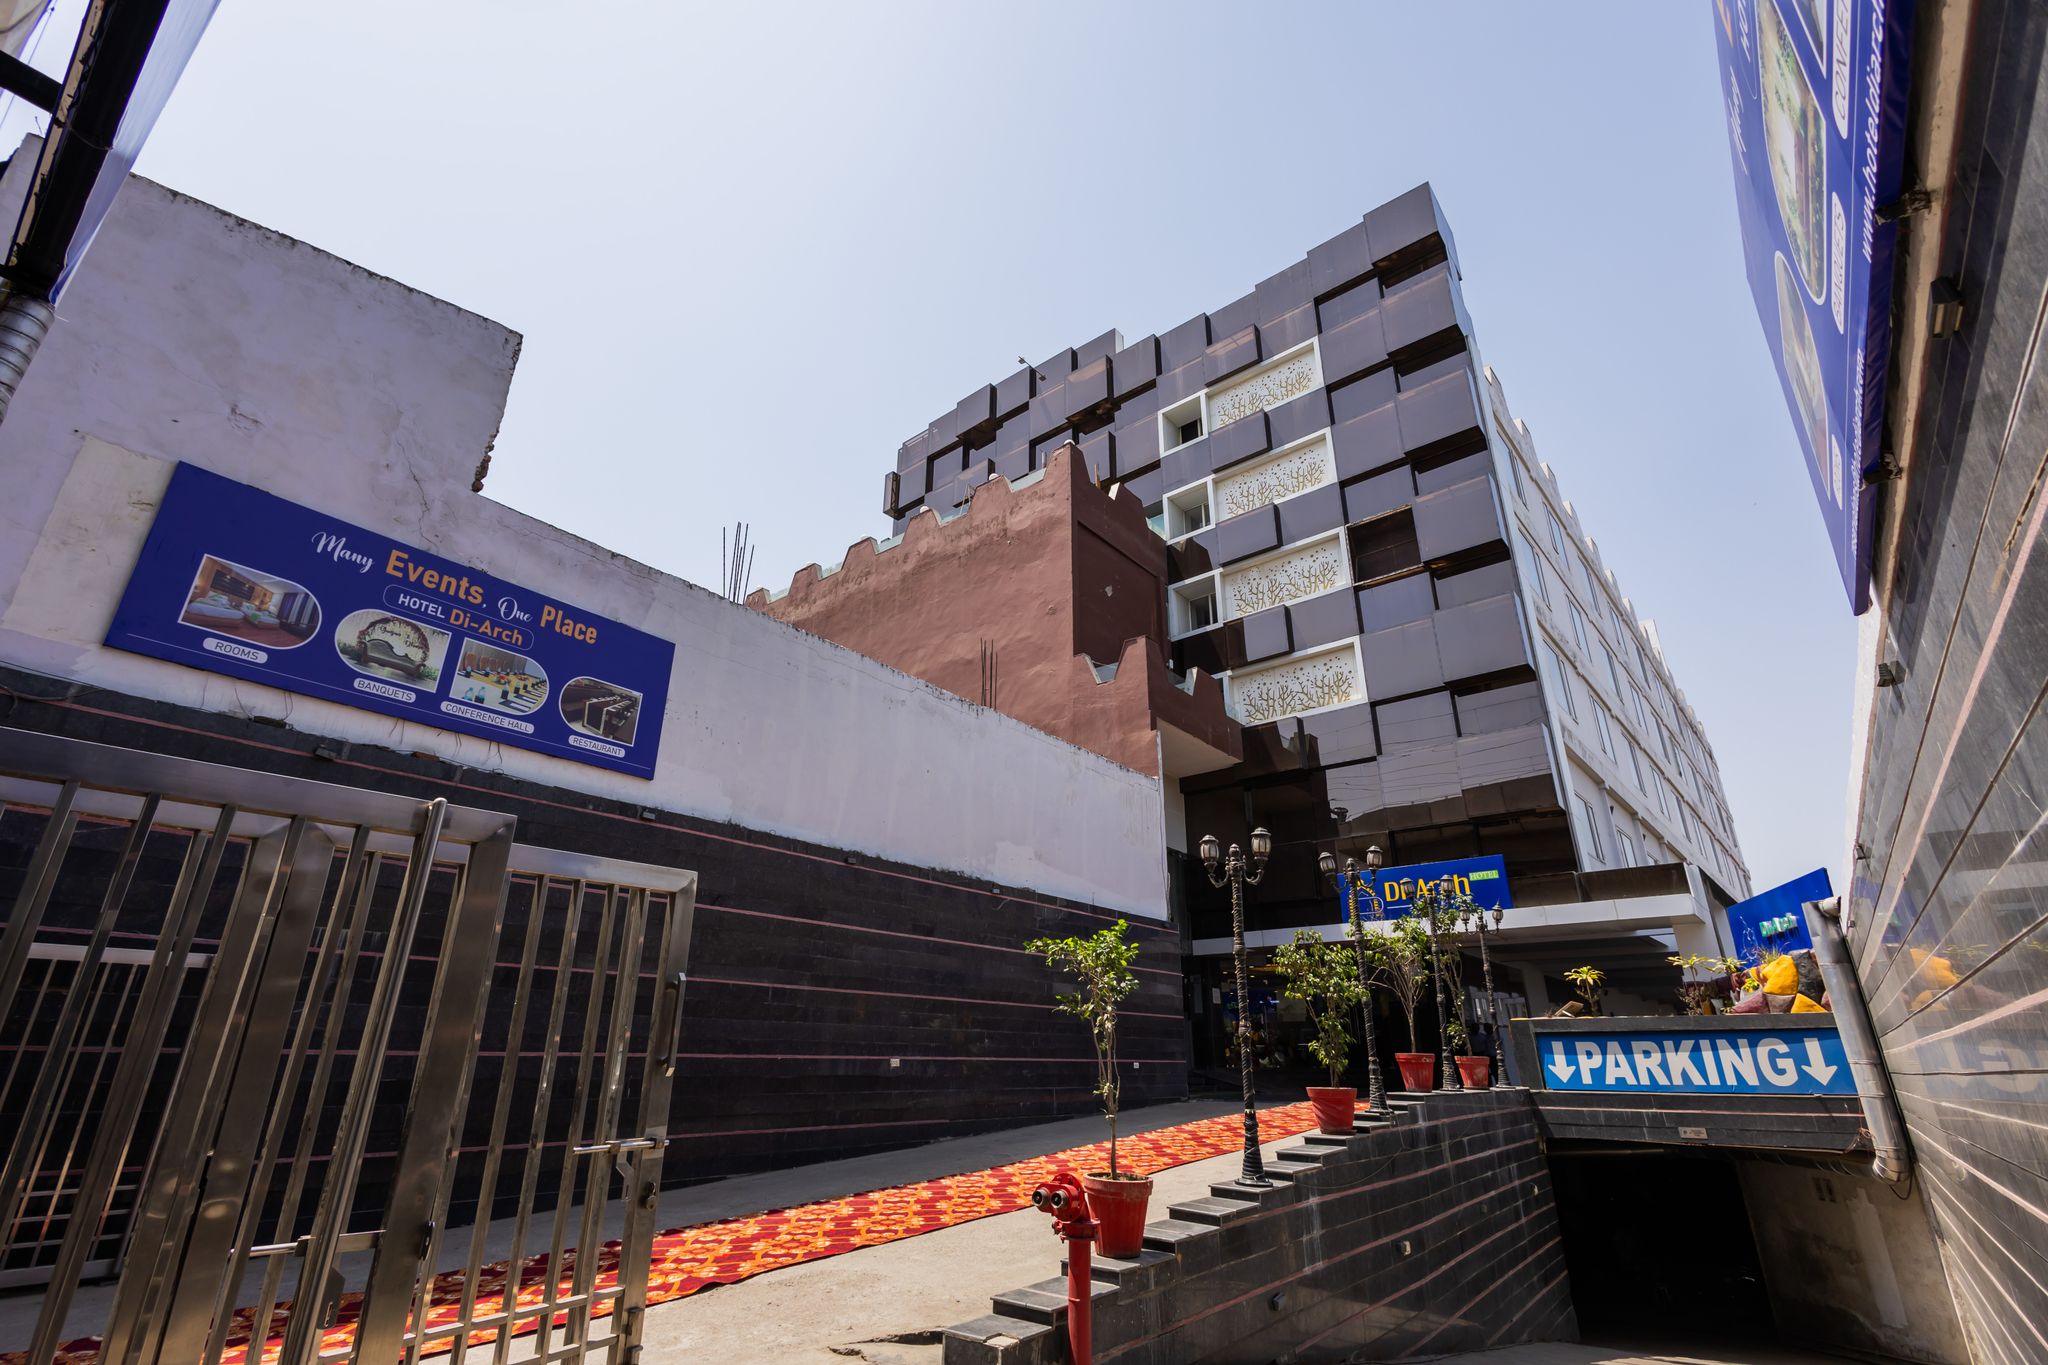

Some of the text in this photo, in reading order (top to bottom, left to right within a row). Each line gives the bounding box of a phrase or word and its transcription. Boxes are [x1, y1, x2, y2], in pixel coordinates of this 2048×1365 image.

[311, 531, 599, 645] Many Events, One Place
[398, 593, 445, 619] HOTEL
[449, 608, 524, 646] Di-Arch
[214, 641, 259, 661] ROOMS
[356, 680, 414, 702] BANQUETS
[445, 703, 531, 733] CONFERENCE HALL
[572, 737, 622, 756] RESTAURANT
[1469, 870, 1498, 880] HOTEL
[1574, 1037, 1799, 1087] PARKING
